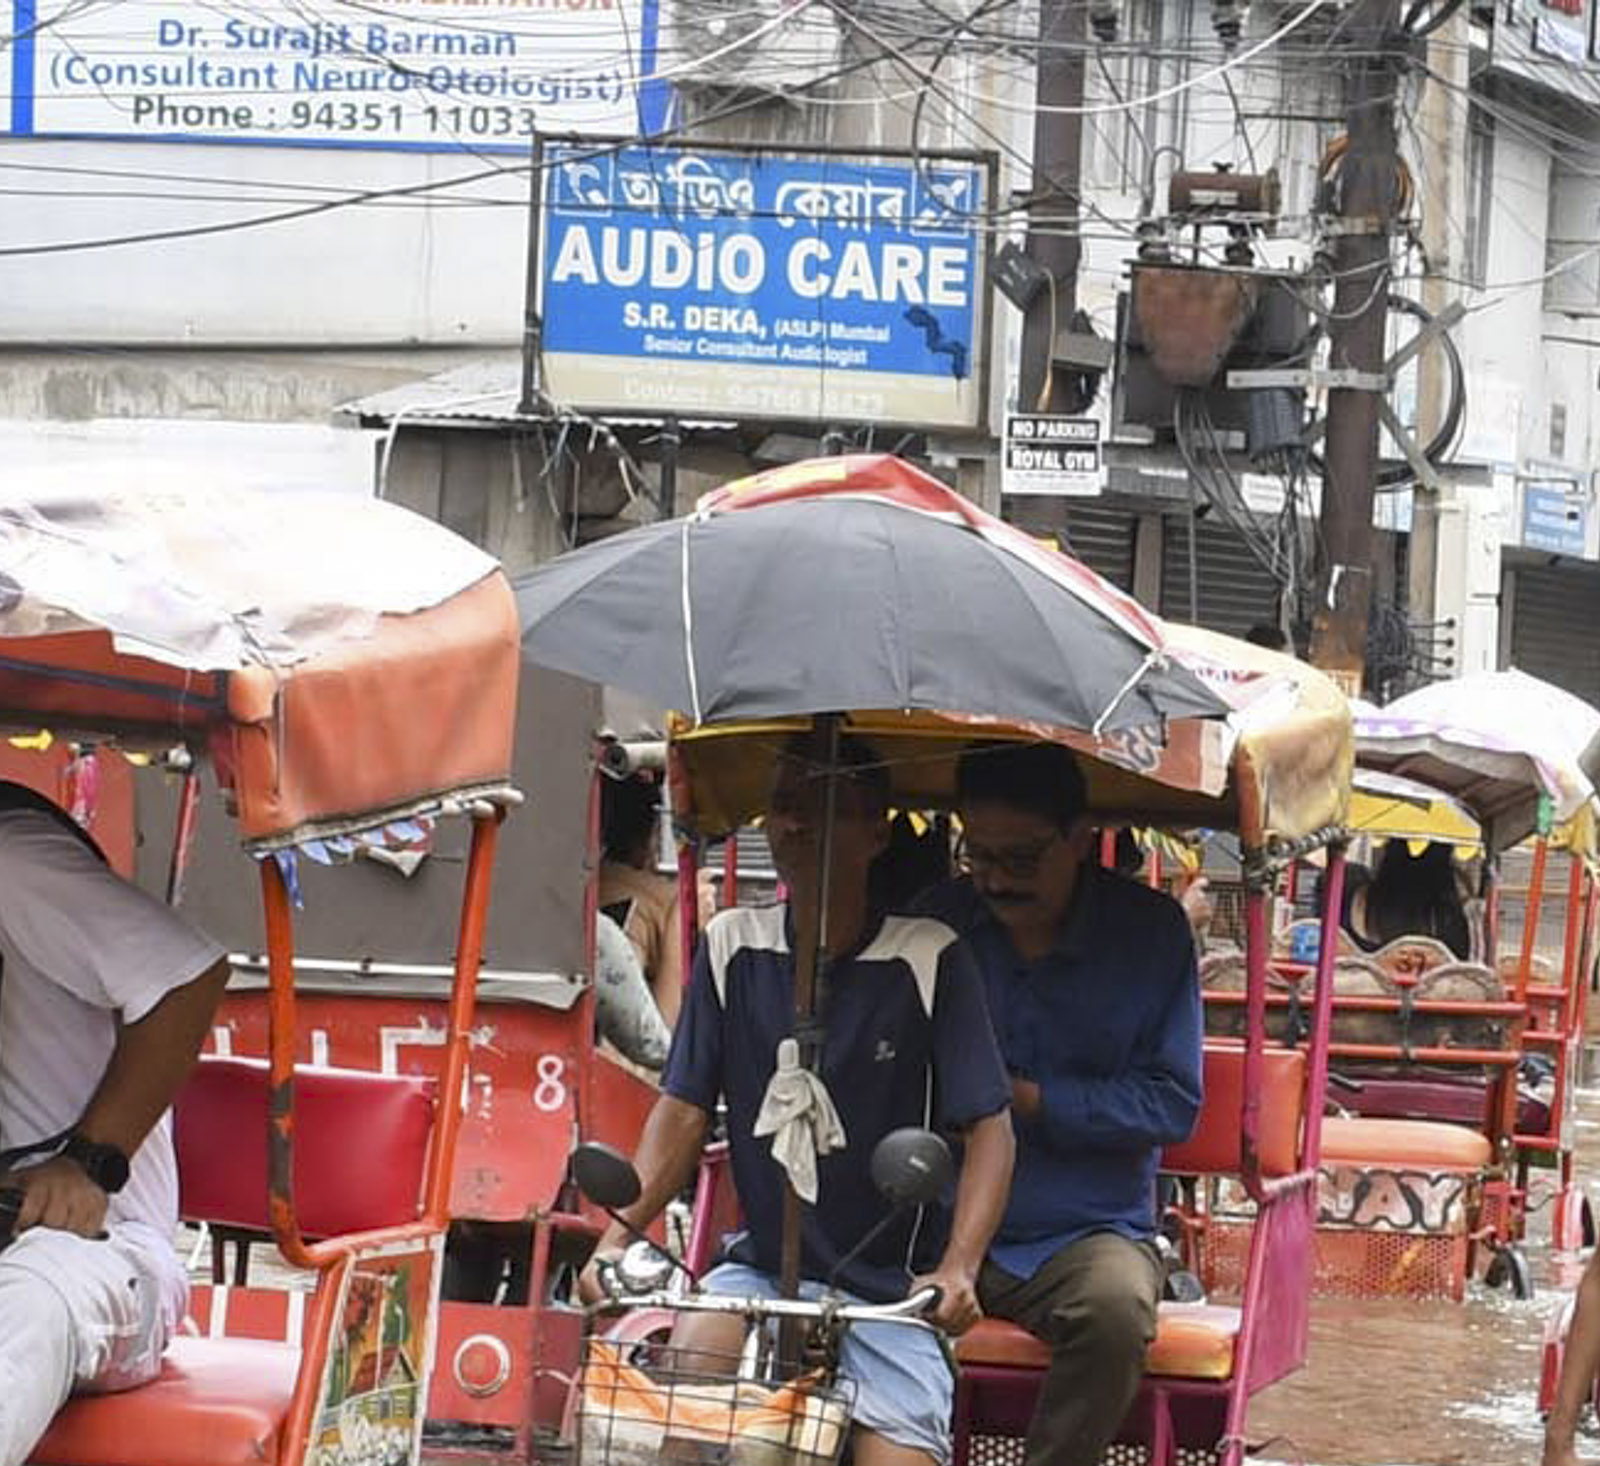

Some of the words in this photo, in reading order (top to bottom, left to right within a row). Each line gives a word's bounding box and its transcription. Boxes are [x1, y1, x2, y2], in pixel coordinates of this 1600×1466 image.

[158, 20, 209, 48] Dr.
[225, 19, 353, 58] Surajit
[367, 25, 517, 56] Barman
[50, 53, 278, 90] (Consultant
[133, 95, 253, 129] Phone
[291, 101, 403, 132] 94351
[424, 104, 536, 136] 11033
[552, 224, 766, 295] AUDIO
[787, 238, 969, 307] CARE
[623, 302, 676, 330] S.R.
[684, 305, 767, 339] DEKA,
[830, 321, 891, 343] Mumbai
[643, 334, 693, 354] Senior
[697, 337, 778, 360] Consultant
[781, 343, 868, 368] Audiologist
[1012, 420, 1034, 438] NO
[1037, 420, 1097, 439] PARKING
[1012, 449, 1062, 470] ROYAL
[1064, 451, 1096, 470] GYM
[533, 1055, 566, 1112] 8
